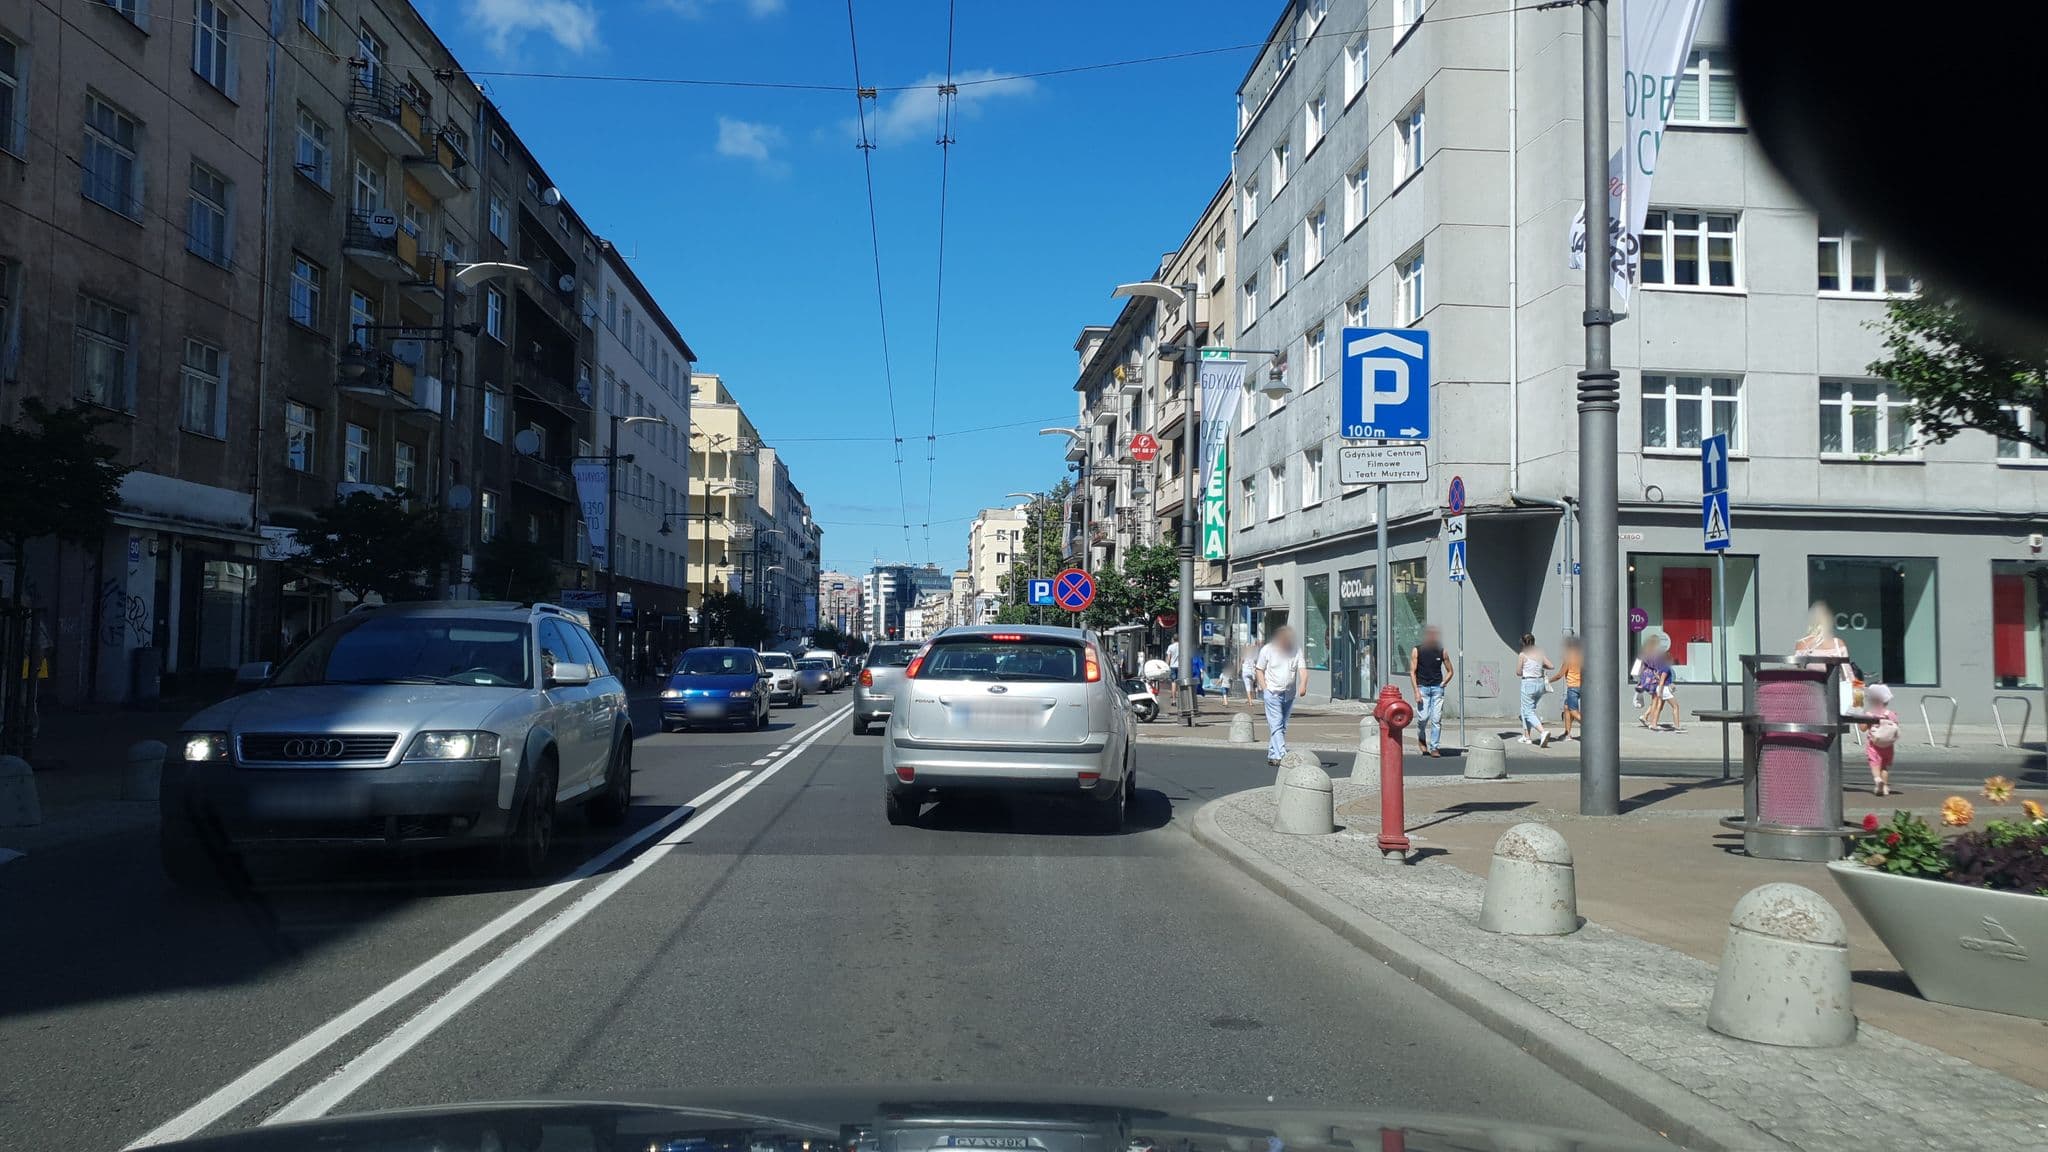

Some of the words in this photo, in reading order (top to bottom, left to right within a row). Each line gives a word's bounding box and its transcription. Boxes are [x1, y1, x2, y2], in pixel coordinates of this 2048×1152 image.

[1201, 373, 1242, 390] GDYNIA
[1362, 357, 1409, 423] P
[1348, 425, 1385, 437] 100m
[1344, 450, 1383, 460] Gdyńskie
[1387, 449, 1422, 457] Centrum
[1367, 460, 1401, 468] Filmowe
[1355, 470, 1377, 478] Teatr
[1381, 470, 1420, 479] Muzyczny
[1206, 470, 1225, 557] EKA
[1034, 581, 1050, 602] P
[1341, 579, 1361, 598] ecco
[1835, 612, 1868, 630] CO
